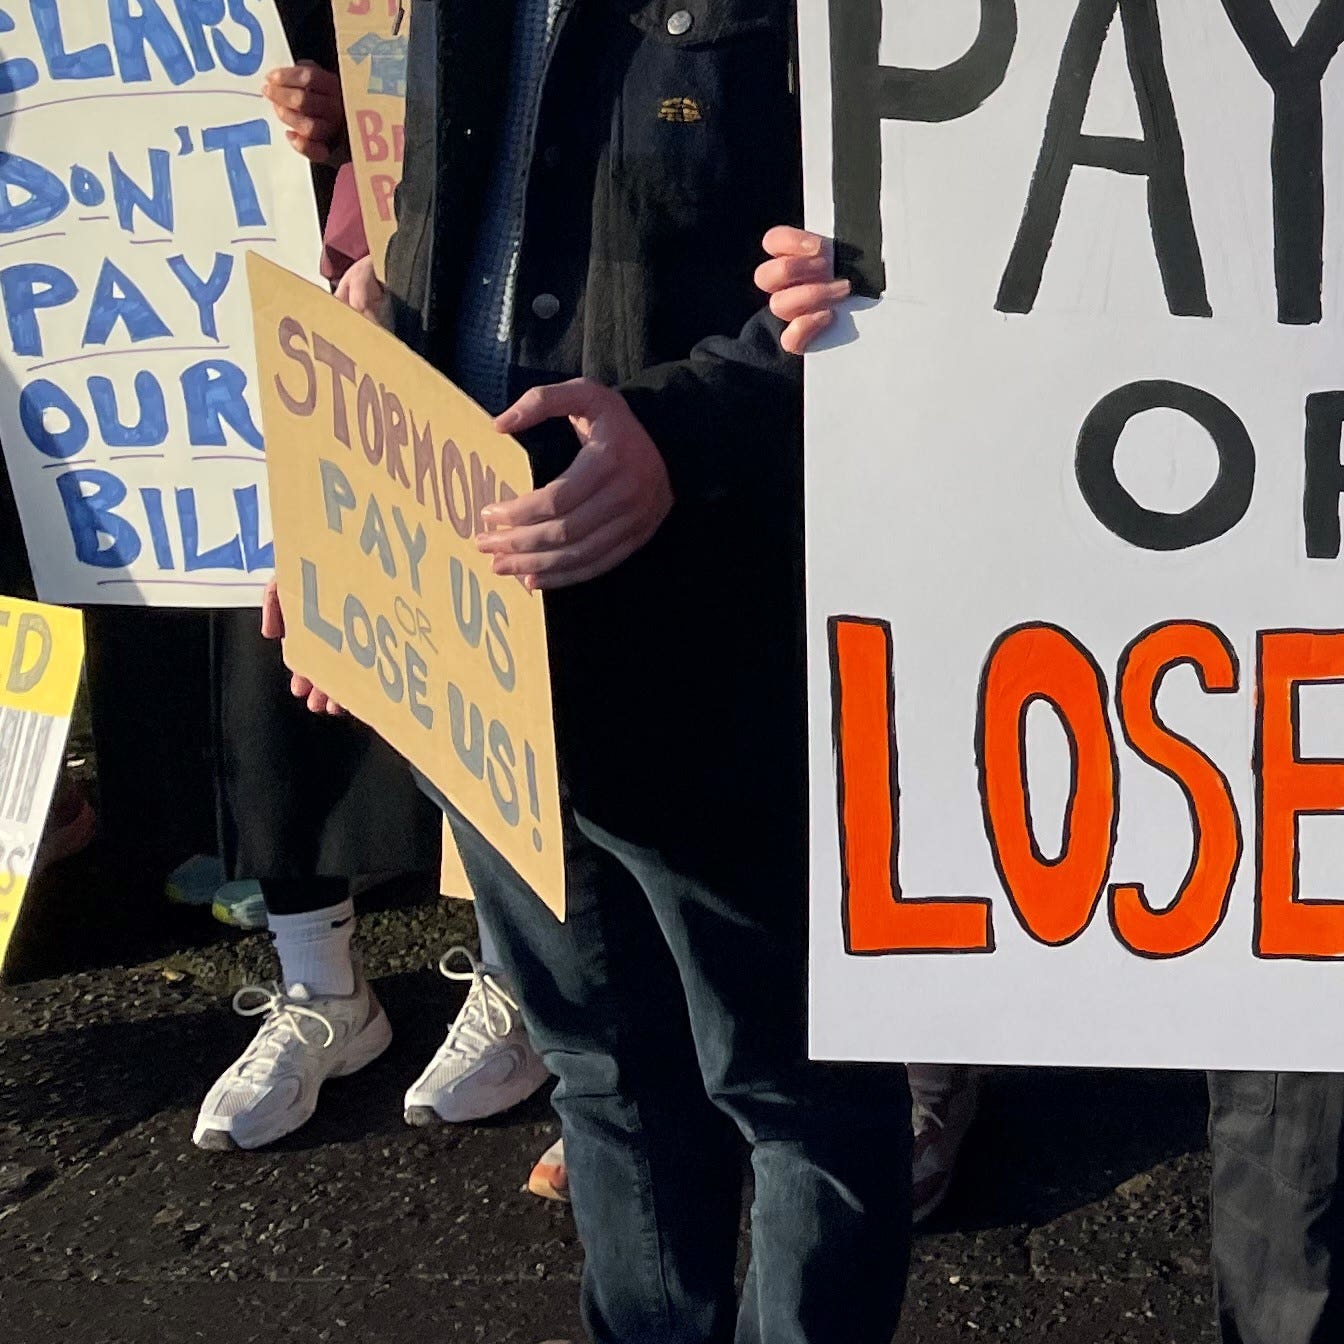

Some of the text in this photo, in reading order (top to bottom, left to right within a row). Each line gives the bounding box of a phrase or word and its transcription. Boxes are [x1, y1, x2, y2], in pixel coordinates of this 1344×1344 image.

[0, 251, 234, 357] PAY
[19, 359, 264, 459] OUR
[56, 468, 276, 574] BILL
[318, 457, 516, 693] PAY US
[394, 595, 439, 655] OR
[300, 556, 543, 853] LOSE US!
